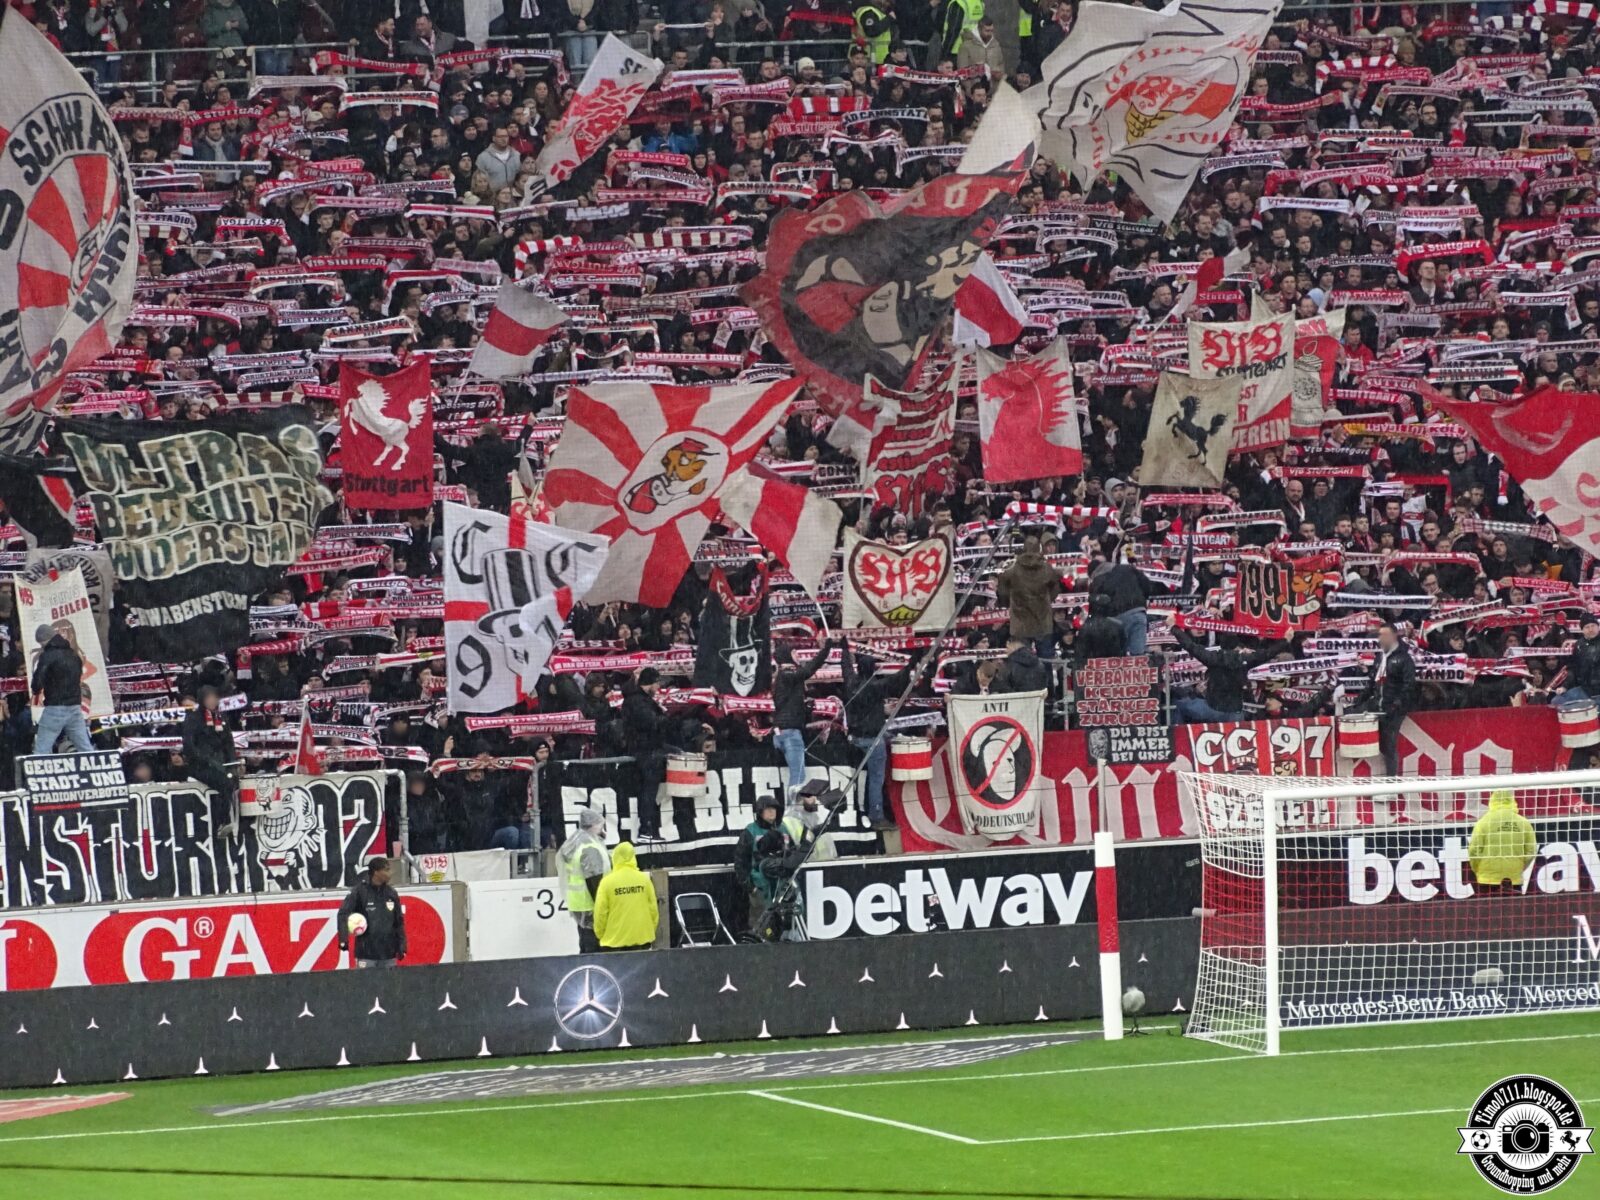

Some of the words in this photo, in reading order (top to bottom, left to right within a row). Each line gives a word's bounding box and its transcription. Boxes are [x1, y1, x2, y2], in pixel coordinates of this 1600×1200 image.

[1408, 245, 1426, 256] VfB
[1427, 240, 1482, 252] Stuttgart
[1203, 322, 1284, 370] VfB
[1336, 389, 1395, 402] STUTTGART
[1324, 446, 1371, 456] Stuttgart
[62, 424, 322, 496] ULTRAS
[818, 466, 860, 477] COMM
[1289, 467, 1306, 475] VfB
[1307, 467, 1354, 475] STUTTGART
[344, 471, 431, 497] Stuttgart
[859, 547, 943, 600] VfB
[1184, 617, 1259, 635] Commando
[1085, 657, 1149, 670] JEDER
[1268, 659, 1339, 673] STUTTGART
[1076, 667, 1159, 687] VERBANNTE
[1084, 684, 1152, 699] KEHRT
[981, 702, 1010, 713] ANTI
[1079, 712, 1158, 727] ZURÜCK
[1110, 728, 1133, 738] DU
[1137, 726, 1169, 737] BIST
[1111, 738, 1170, 752] IMMER
[1195, 728, 1257, 767] CC
[1271, 726, 1333, 760] 97
[1112, 751, 1133, 762] BEI
[1138, 750, 1171, 760] UNS!
[24, 758, 77, 776] GEGEN
[80, 753, 122, 770] ALLE
[26, 777, 89, 792] STADT-
[91, 770, 126, 786] UND
[614, 885, 645, 896] SECURITY
[805, 867, 1094, 940] betway
[122, 906, 352, 985] GAZ
[1287, 994, 1445, 1020] Mercedes-Benz
[1451, 989, 1506, 1012] Bank
